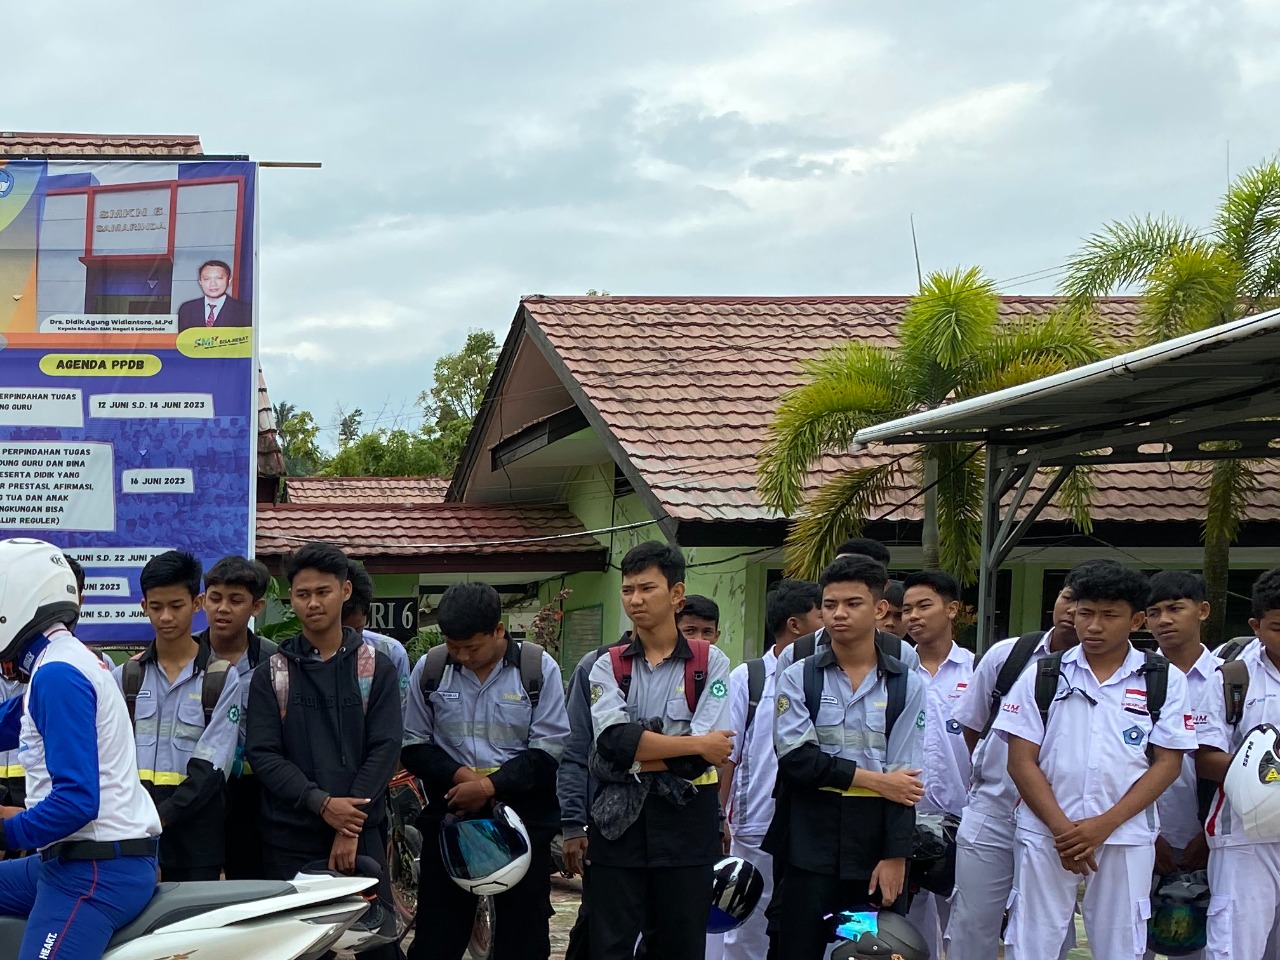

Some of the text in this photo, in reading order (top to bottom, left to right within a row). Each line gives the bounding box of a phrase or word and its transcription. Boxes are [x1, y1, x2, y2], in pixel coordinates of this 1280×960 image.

[99, 207, 164, 218] SMKN 6
[96, 222, 166, 232] SAMARINDA
[56, 360, 144, 369] AGENDA PPDB
[2, 448, 60, 456] PERPINDAHAN
[53, 483, 94, 491] AFIRMASI,
[46, 494, 69, 502] ANAK
[20, 516, 60, 525] REGULER)
[367, 601, 414, 628] RI 6
[39, 932, 58, 960] HEART.
